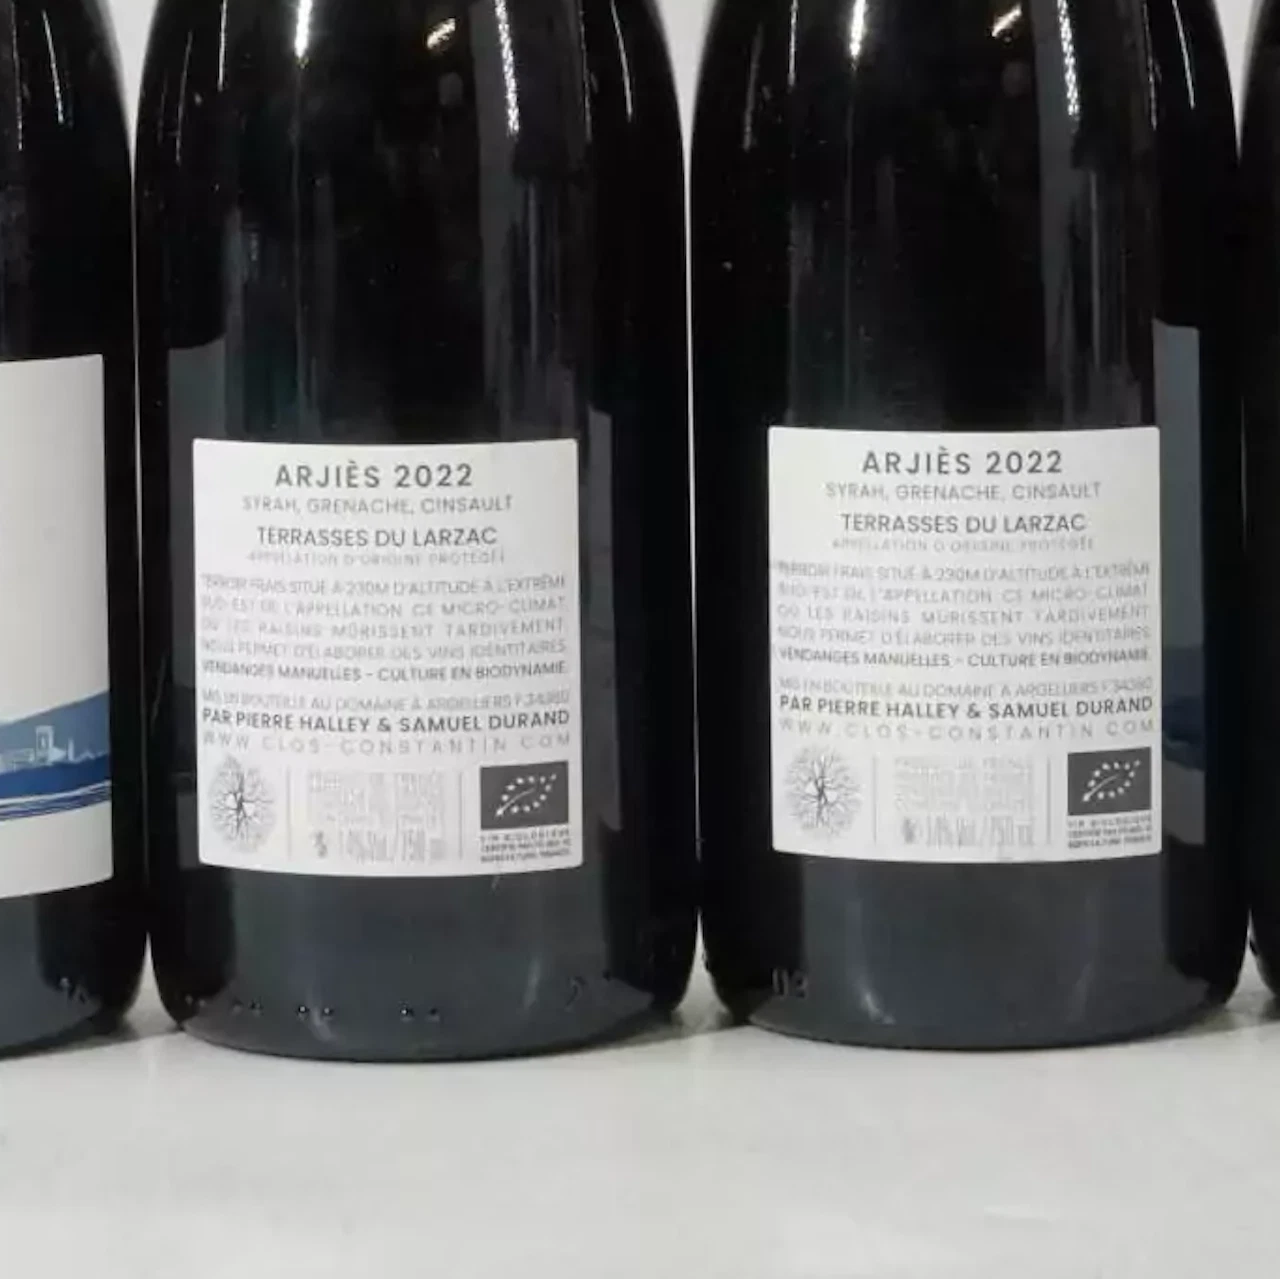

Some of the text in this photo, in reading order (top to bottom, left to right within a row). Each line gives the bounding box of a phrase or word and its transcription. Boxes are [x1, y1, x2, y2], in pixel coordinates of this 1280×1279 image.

[861, 446, 1063, 475] ARJIÈS 2022
[274, 460, 473, 488] ARJIÈS 2022
[825, 480, 1101, 501] SYRAH, GRENACHE, CINSAULT
[242, 494, 513, 514] SYRAH, GRENACHE, CINSAULT
[840, 512, 1087, 534] TERRASSES DU LARZAC
[256, 525, 498, 548] TERRASSES DU LARZAC
[779, 647, 859, 665] VENDANGES
[863, 652, 950, 668] MANUELLES
[967, 652, 1034, 668] CULTURE
[1040, 651, 1059, 667] EN
[278, 664, 361, 681] MANUELLES
[377, 665, 446, 681] CULTURE
[451, 665, 471, 680] EN
[779, 694, 1153, 719] PAR PIERRE HALLEY & SAMUEL DURAND
[202, 706, 571, 733] PAR PIERRE HALLEY & SAMUEL DURAND
